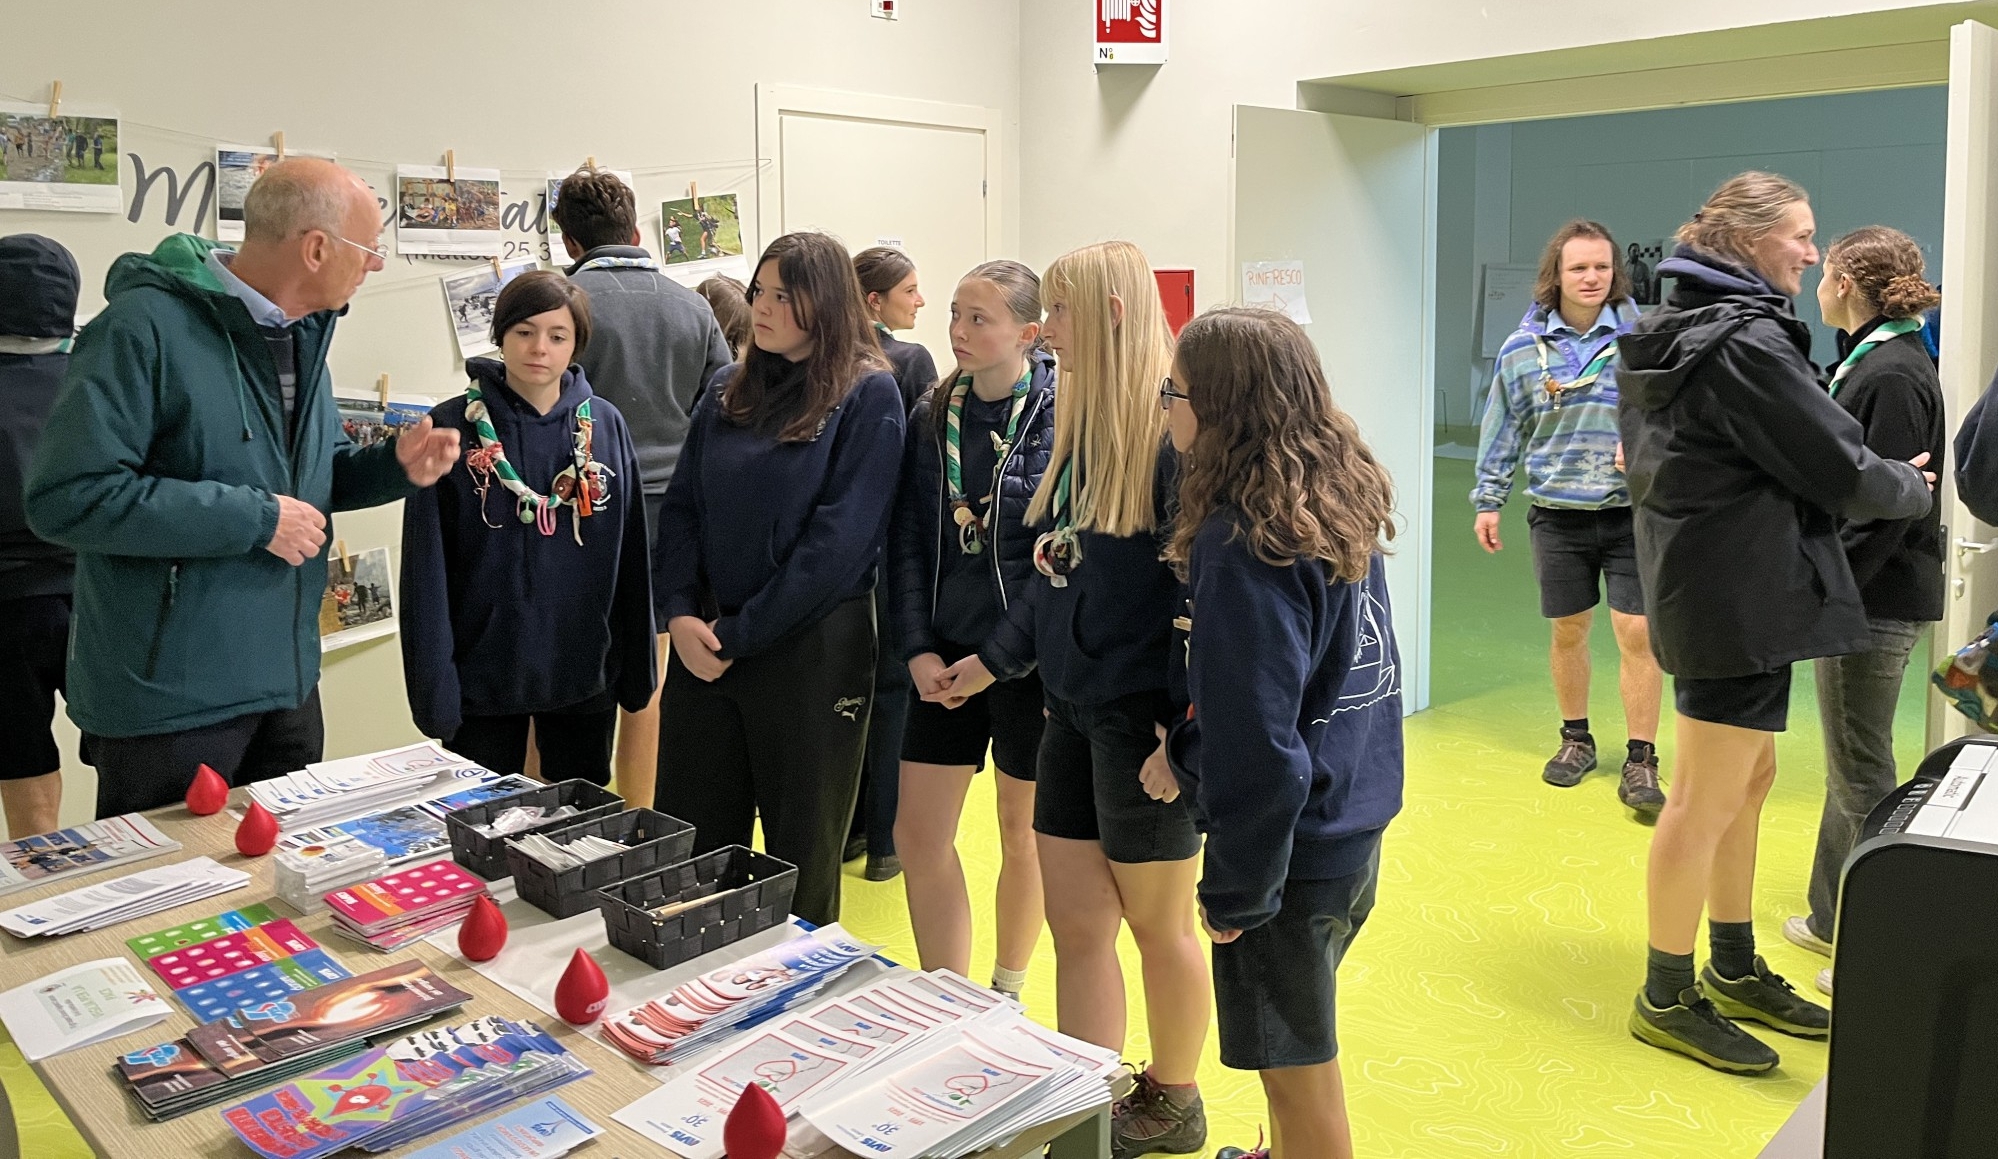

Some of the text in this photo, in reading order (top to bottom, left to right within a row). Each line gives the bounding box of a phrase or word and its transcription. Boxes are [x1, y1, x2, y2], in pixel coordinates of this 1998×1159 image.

[877, 239, 902, 247] TOILETTE
[1245, 268, 1302, 286] RINFRESCO
[871, 1122, 900, 1136] 30°
[668, 1130, 702, 1147] AVIS
[859, 1137, 893, 1153] AVIS
